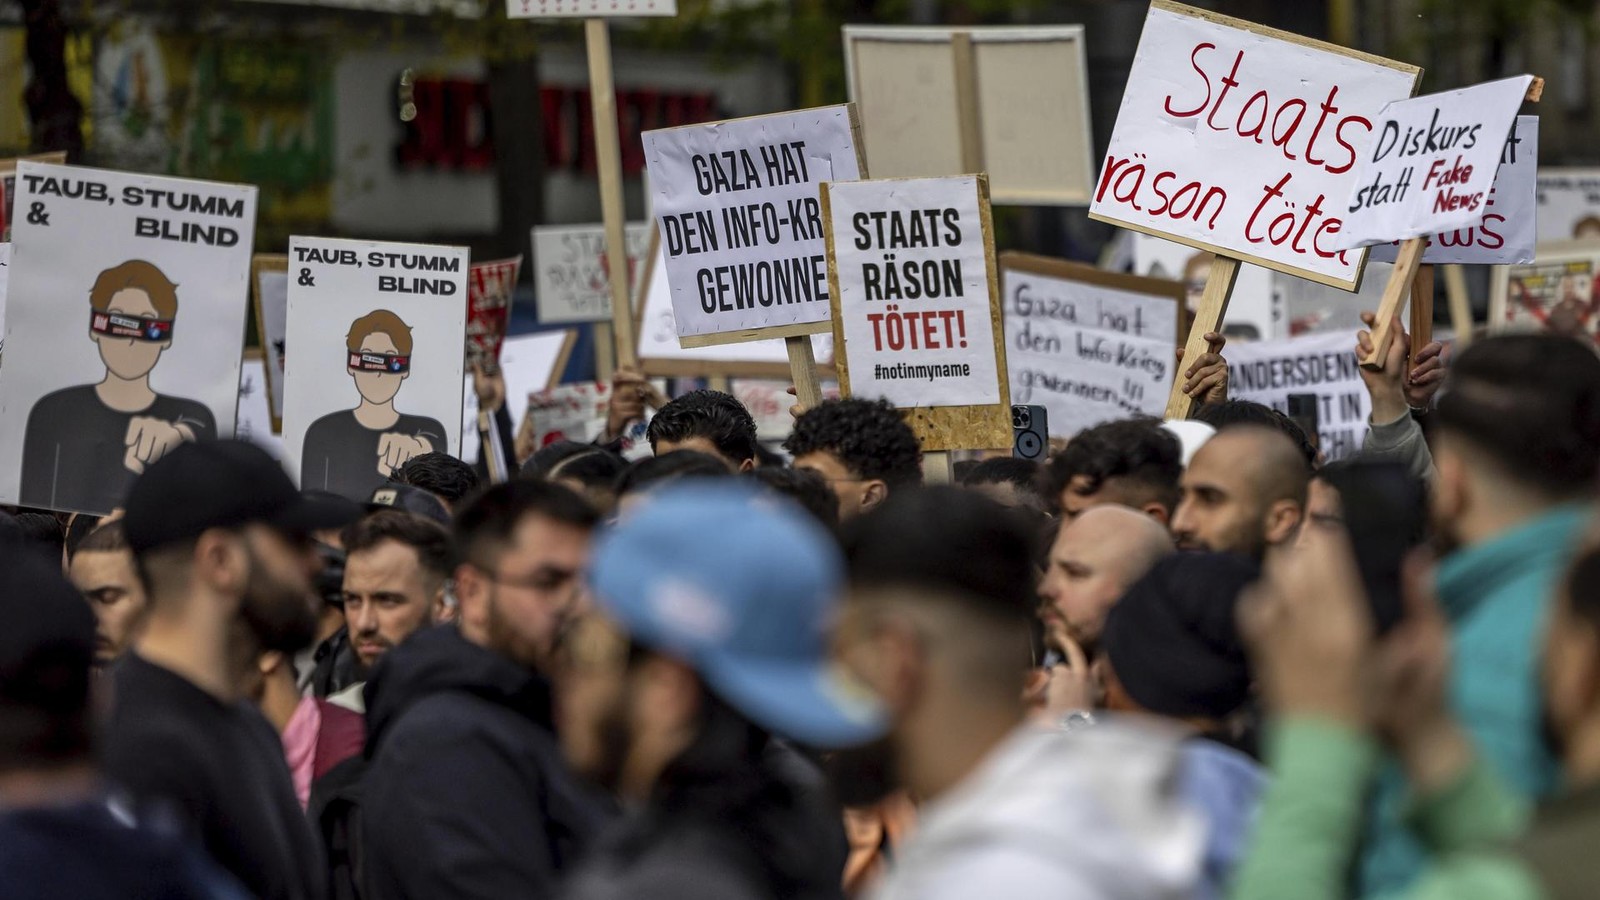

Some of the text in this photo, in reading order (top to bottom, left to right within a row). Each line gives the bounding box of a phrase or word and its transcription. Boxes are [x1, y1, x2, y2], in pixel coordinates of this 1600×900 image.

[1164, 42, 1373, 174] Staats
[1372, 107, 1483, 163] Diskurs
[691, 140, 809, 196] GAZA HAT
[1096, 152, 1228, 231] räson
[1348, 166, 1414, 213] statt
[1422, 154, 1474, 191] Fake
[23, 174, 245, 218] TAUB, STUMM
[1432, 187, 1484, 214] News
[26, 201, 240, 248] & BLIND
[662, 210, 719, 257] DEN
[722, 197, 824, 250] INFO-KR
[852, 207, 963, 251] STAATS
[293, 246, 460, 273] TAUB, STUMM
[297, 267, 457, 297] & BLIND
[862, 253, 964, 301] RÄSON
[696, 254, 830, 314] GEWONNE
[867, 304, 968, 351] TÖTET!
[1014, 283, 1147, 337] Gaza hat
[1015, 319, 1062, 354] den
[874, 362, 971, 382] #notinmyname
